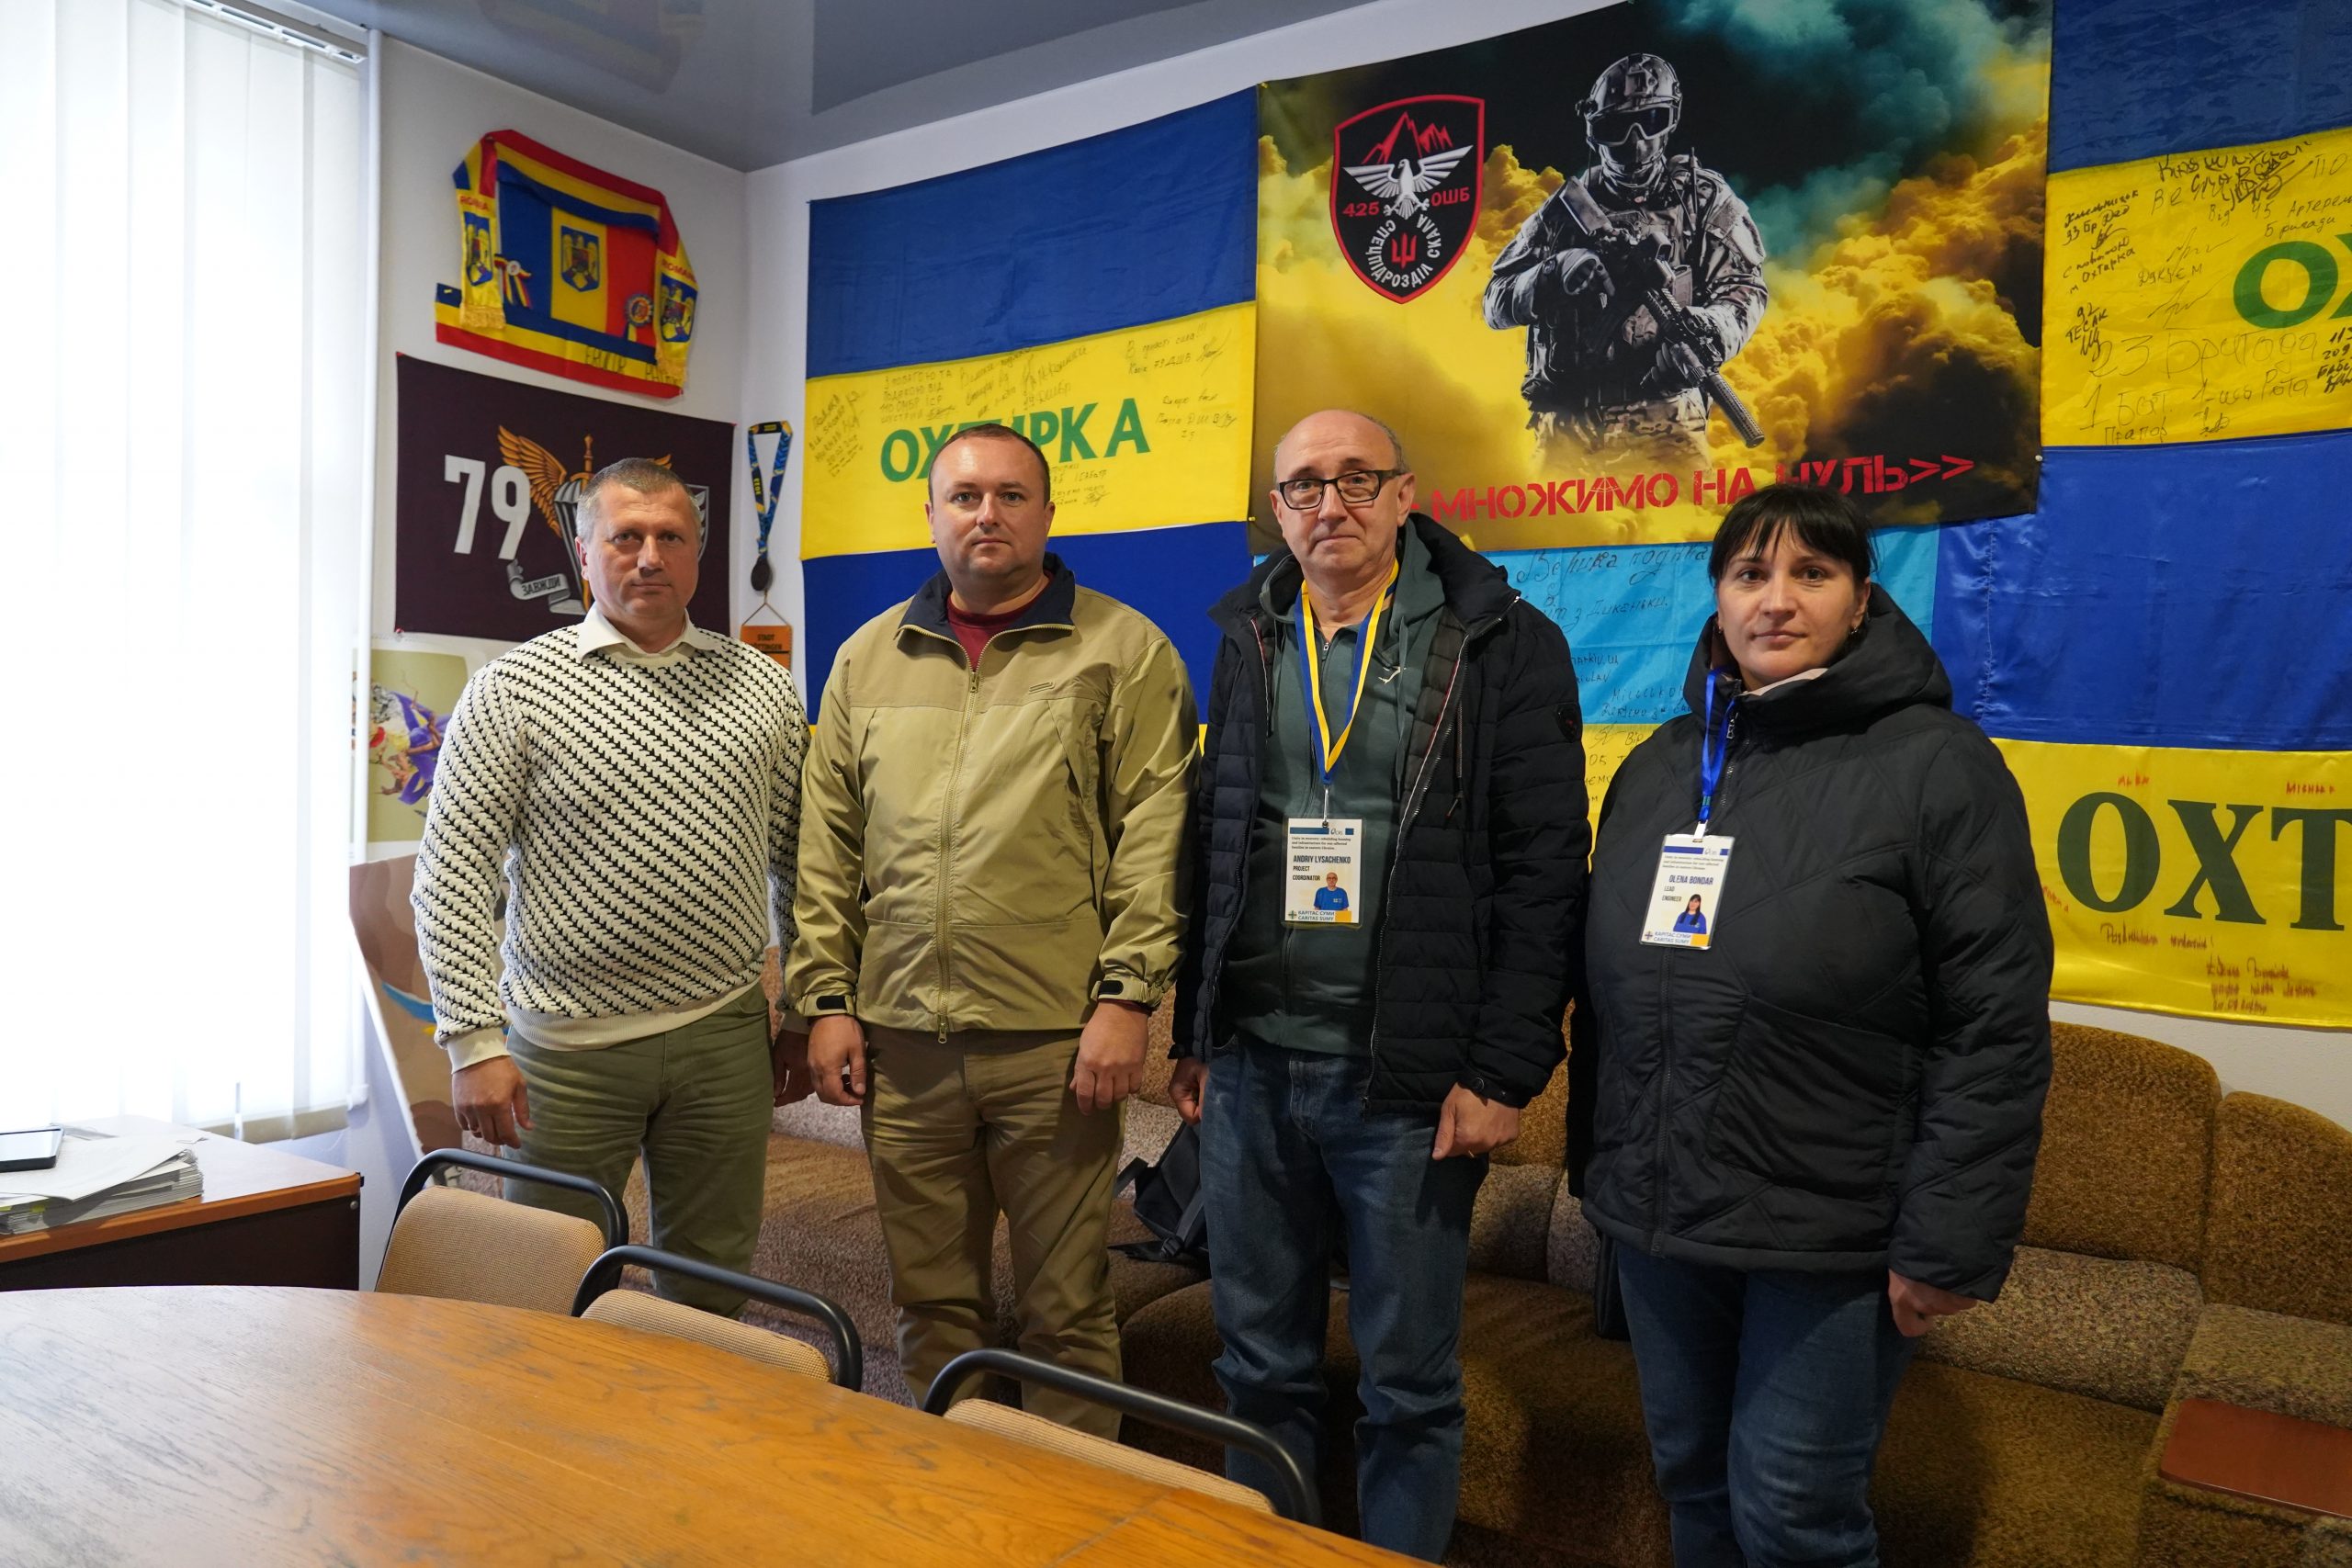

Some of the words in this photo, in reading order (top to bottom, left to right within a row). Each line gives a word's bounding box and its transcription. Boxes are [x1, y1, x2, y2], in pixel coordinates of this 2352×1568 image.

[1342, 201, 1380, 218] 425
[1430, 186, 1471, 208] ОШБ
[1365, 220, 1434, 288] СПЕЦПІДРОЗДІЛ
[1416, 213, 1442, 259] СКАЛА
[881, 398, 1151, 482] ОХРКА
[444, 454, 531, 560] 79
[1430, 469, 1679, 522] МНОЖИМО
[1693, 468, 1758, 506] НА
[1293, 854, 1313, 863] ANDRIY
[1315, 854, 1351, 864] LYSACHENKO
[1668, 874, 1688, 883] OLENA
[1689, 875, 1713, 886] BONDAR
